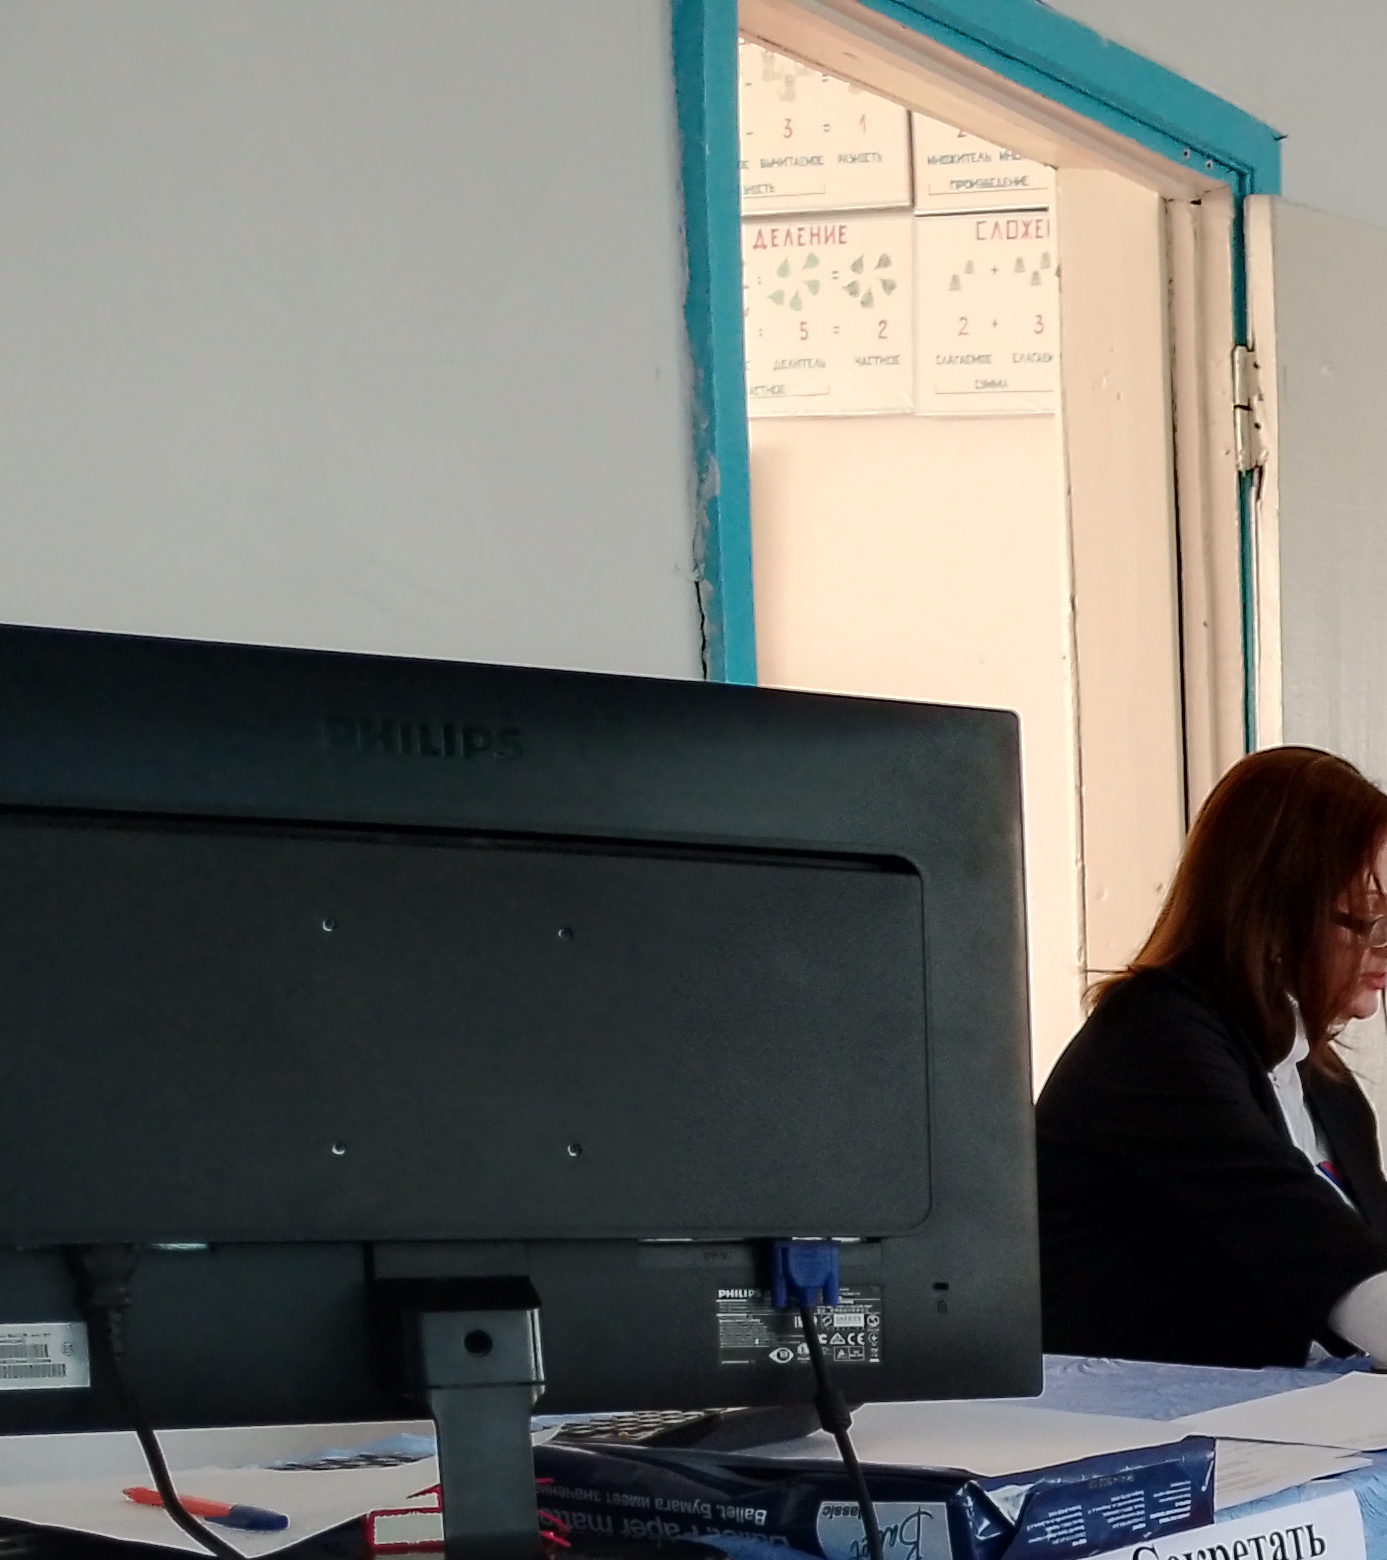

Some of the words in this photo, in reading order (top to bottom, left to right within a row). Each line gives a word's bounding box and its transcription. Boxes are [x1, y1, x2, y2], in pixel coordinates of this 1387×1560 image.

[783, 118, 793, 139] 3
[752, 225, 848, 250] ДЕЛЕНИЕ
[799, 321, 809, 341] 5
[878, 319, 888, 340] 2
[959, 316, 969, 336] 2
[1033, 314, 1045, 335] 3
[320, 717, 524, 761] PHILIPS
[605, 1491, 651, 1510] имеет
[654, 1497, 711, 1519] Бумага
[821, 1505, 860, 1520] lassic
